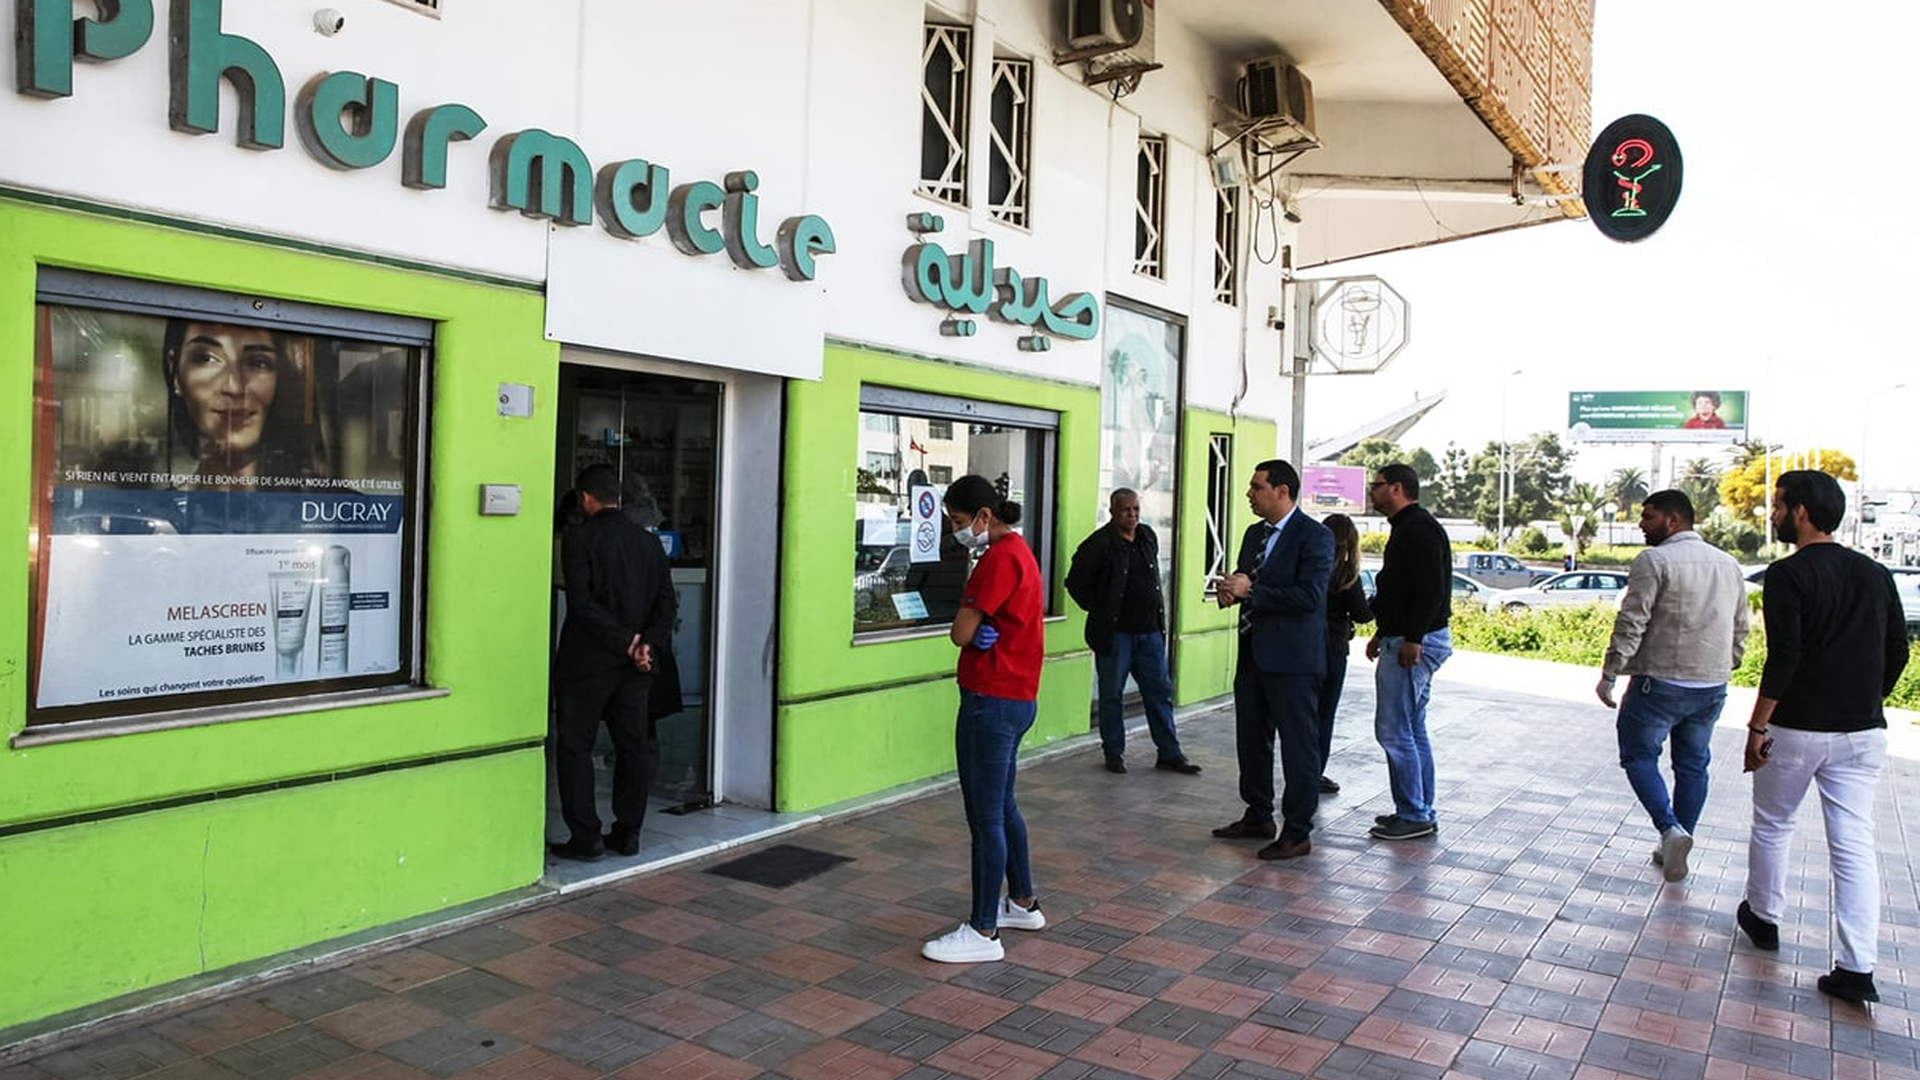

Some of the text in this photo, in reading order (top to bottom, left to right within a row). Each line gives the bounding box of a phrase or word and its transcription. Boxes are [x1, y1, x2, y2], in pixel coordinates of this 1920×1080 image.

[15, 0, 836, 282] Pharmacie
[902, 212, 1100, 352] صيدلية
[65, 470, 75, 481] SI
[76, 471, 101, 481] RIEN
[103, 471, 117, 482] NE
[119, 472, 149, 483] VIENT
[151, 473, 201, 484] ENTACHER
[202, 474, 213, 485] LE
[215, 474, 259, 486] BONHEUR
[261, 476, 272, 486] DE
[305, 478, 330, 488] NOUS
[331, 478, 360, 489] AVONS
[361, 477, 375, 489] ÉTÉ
[301, 500, 393, 522] DUCRAY
[292, 560, 317, 569] mois
[167, 602, 267, 621] MELASCREEN
[128, 634, 142, 646] LA
[145, 632, 185, 645] GAMME
[187, 628, 245, 643] SPÉCIALISTE
[248, 626, 266, 638] DES
[184, 641, 266, 657] TACHES BRUNES
[99, 674, 265, 698] Les soins qui changent votre quotidien
